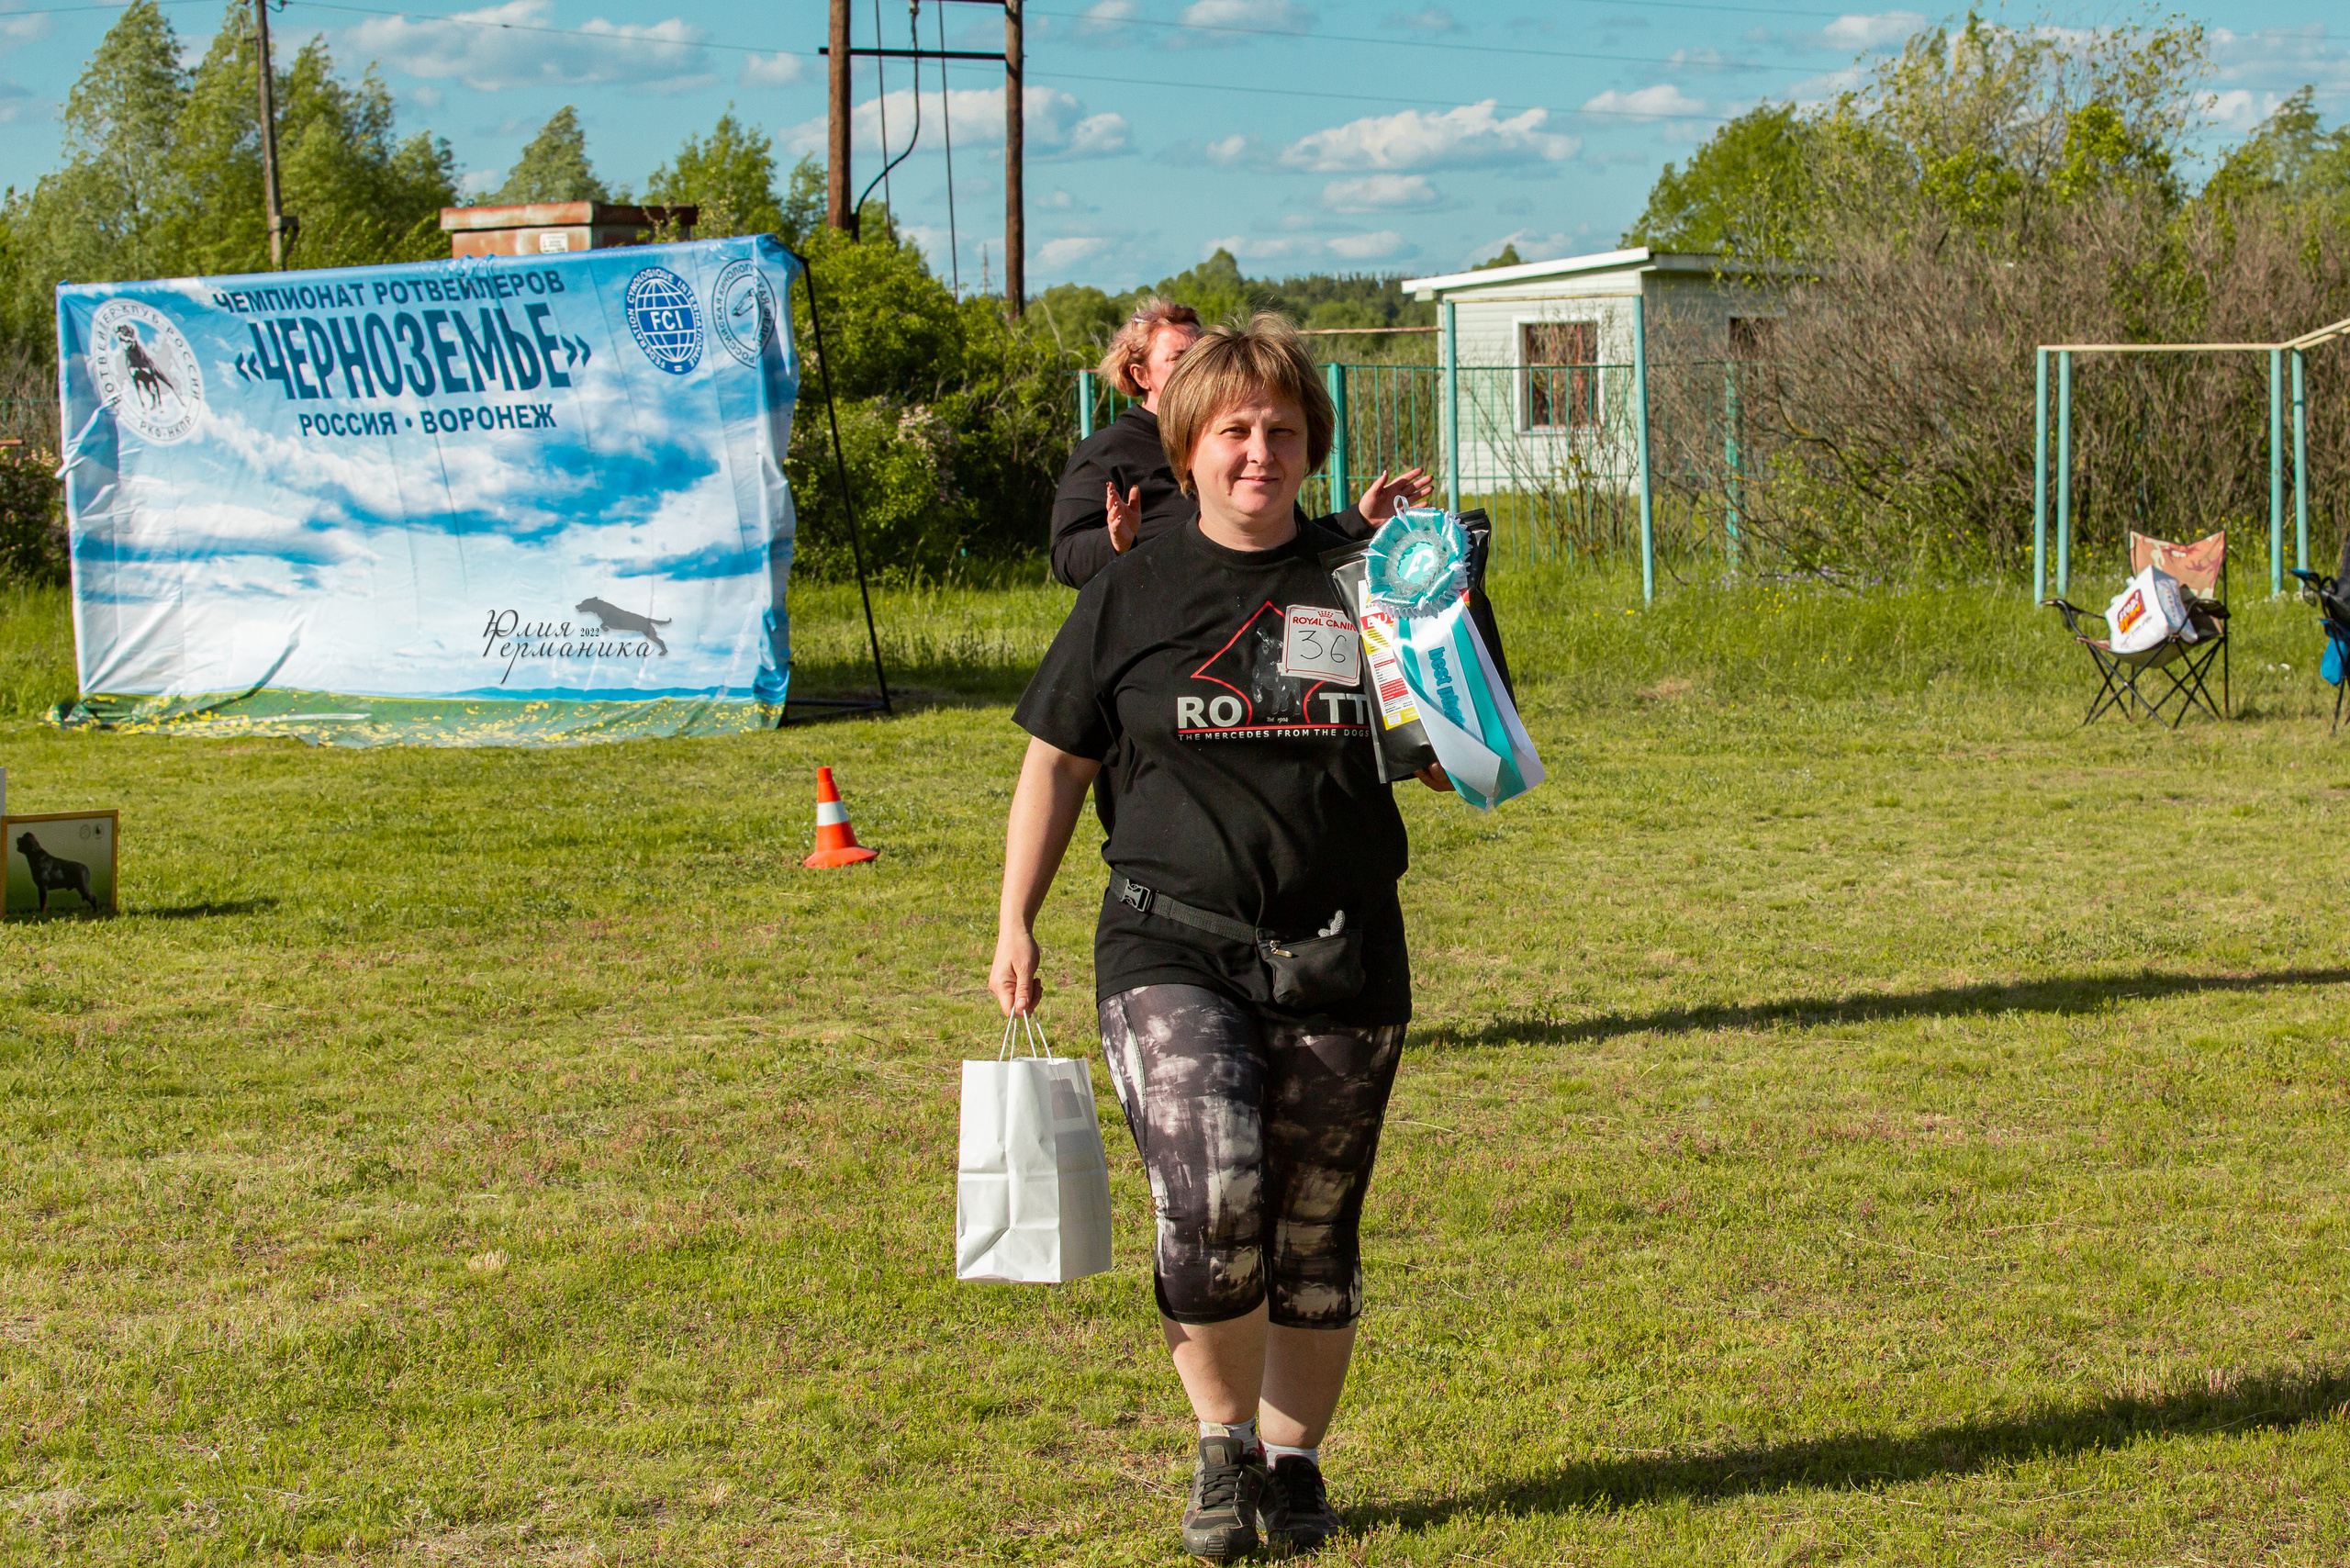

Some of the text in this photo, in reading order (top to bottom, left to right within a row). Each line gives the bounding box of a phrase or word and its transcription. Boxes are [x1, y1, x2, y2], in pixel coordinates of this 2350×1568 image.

[212, 270, 565, 314] ЧЕМПИОНАТ РОТВЕЙЛЕРОВ
[627, 268, 675, 304] CYNOLOGIQUE
[650, 309, 684, 331] FCI
[716, 297, 755, 364] РОССИЙСКАЯ
[234, 301, 592, 400] «ЧЕРНОЗЕМЬЕ»
[627, 308, 666, 369] FEDERATION
[166, 326, 201, 401] РОССИИ
[140, 415, 193, 439] РКФ-НКПР
[298, 403, 557, 437] РОССИЯ ВОРОНЕЖ
[482, 609, 576, 638] Юлия
[580, 627, 599, 637] 2022
[1292, 616, 1325, 627] ROYAL
[482, 628, 655, 685] Германика
[1298, 630, 1347, 664] 36
[1427, 645, 1452, 687] best
[1177, 695, 1243, 729] RO
[1178, 728, 1370, 742] THE MERCEDES FROM THE DOGS
